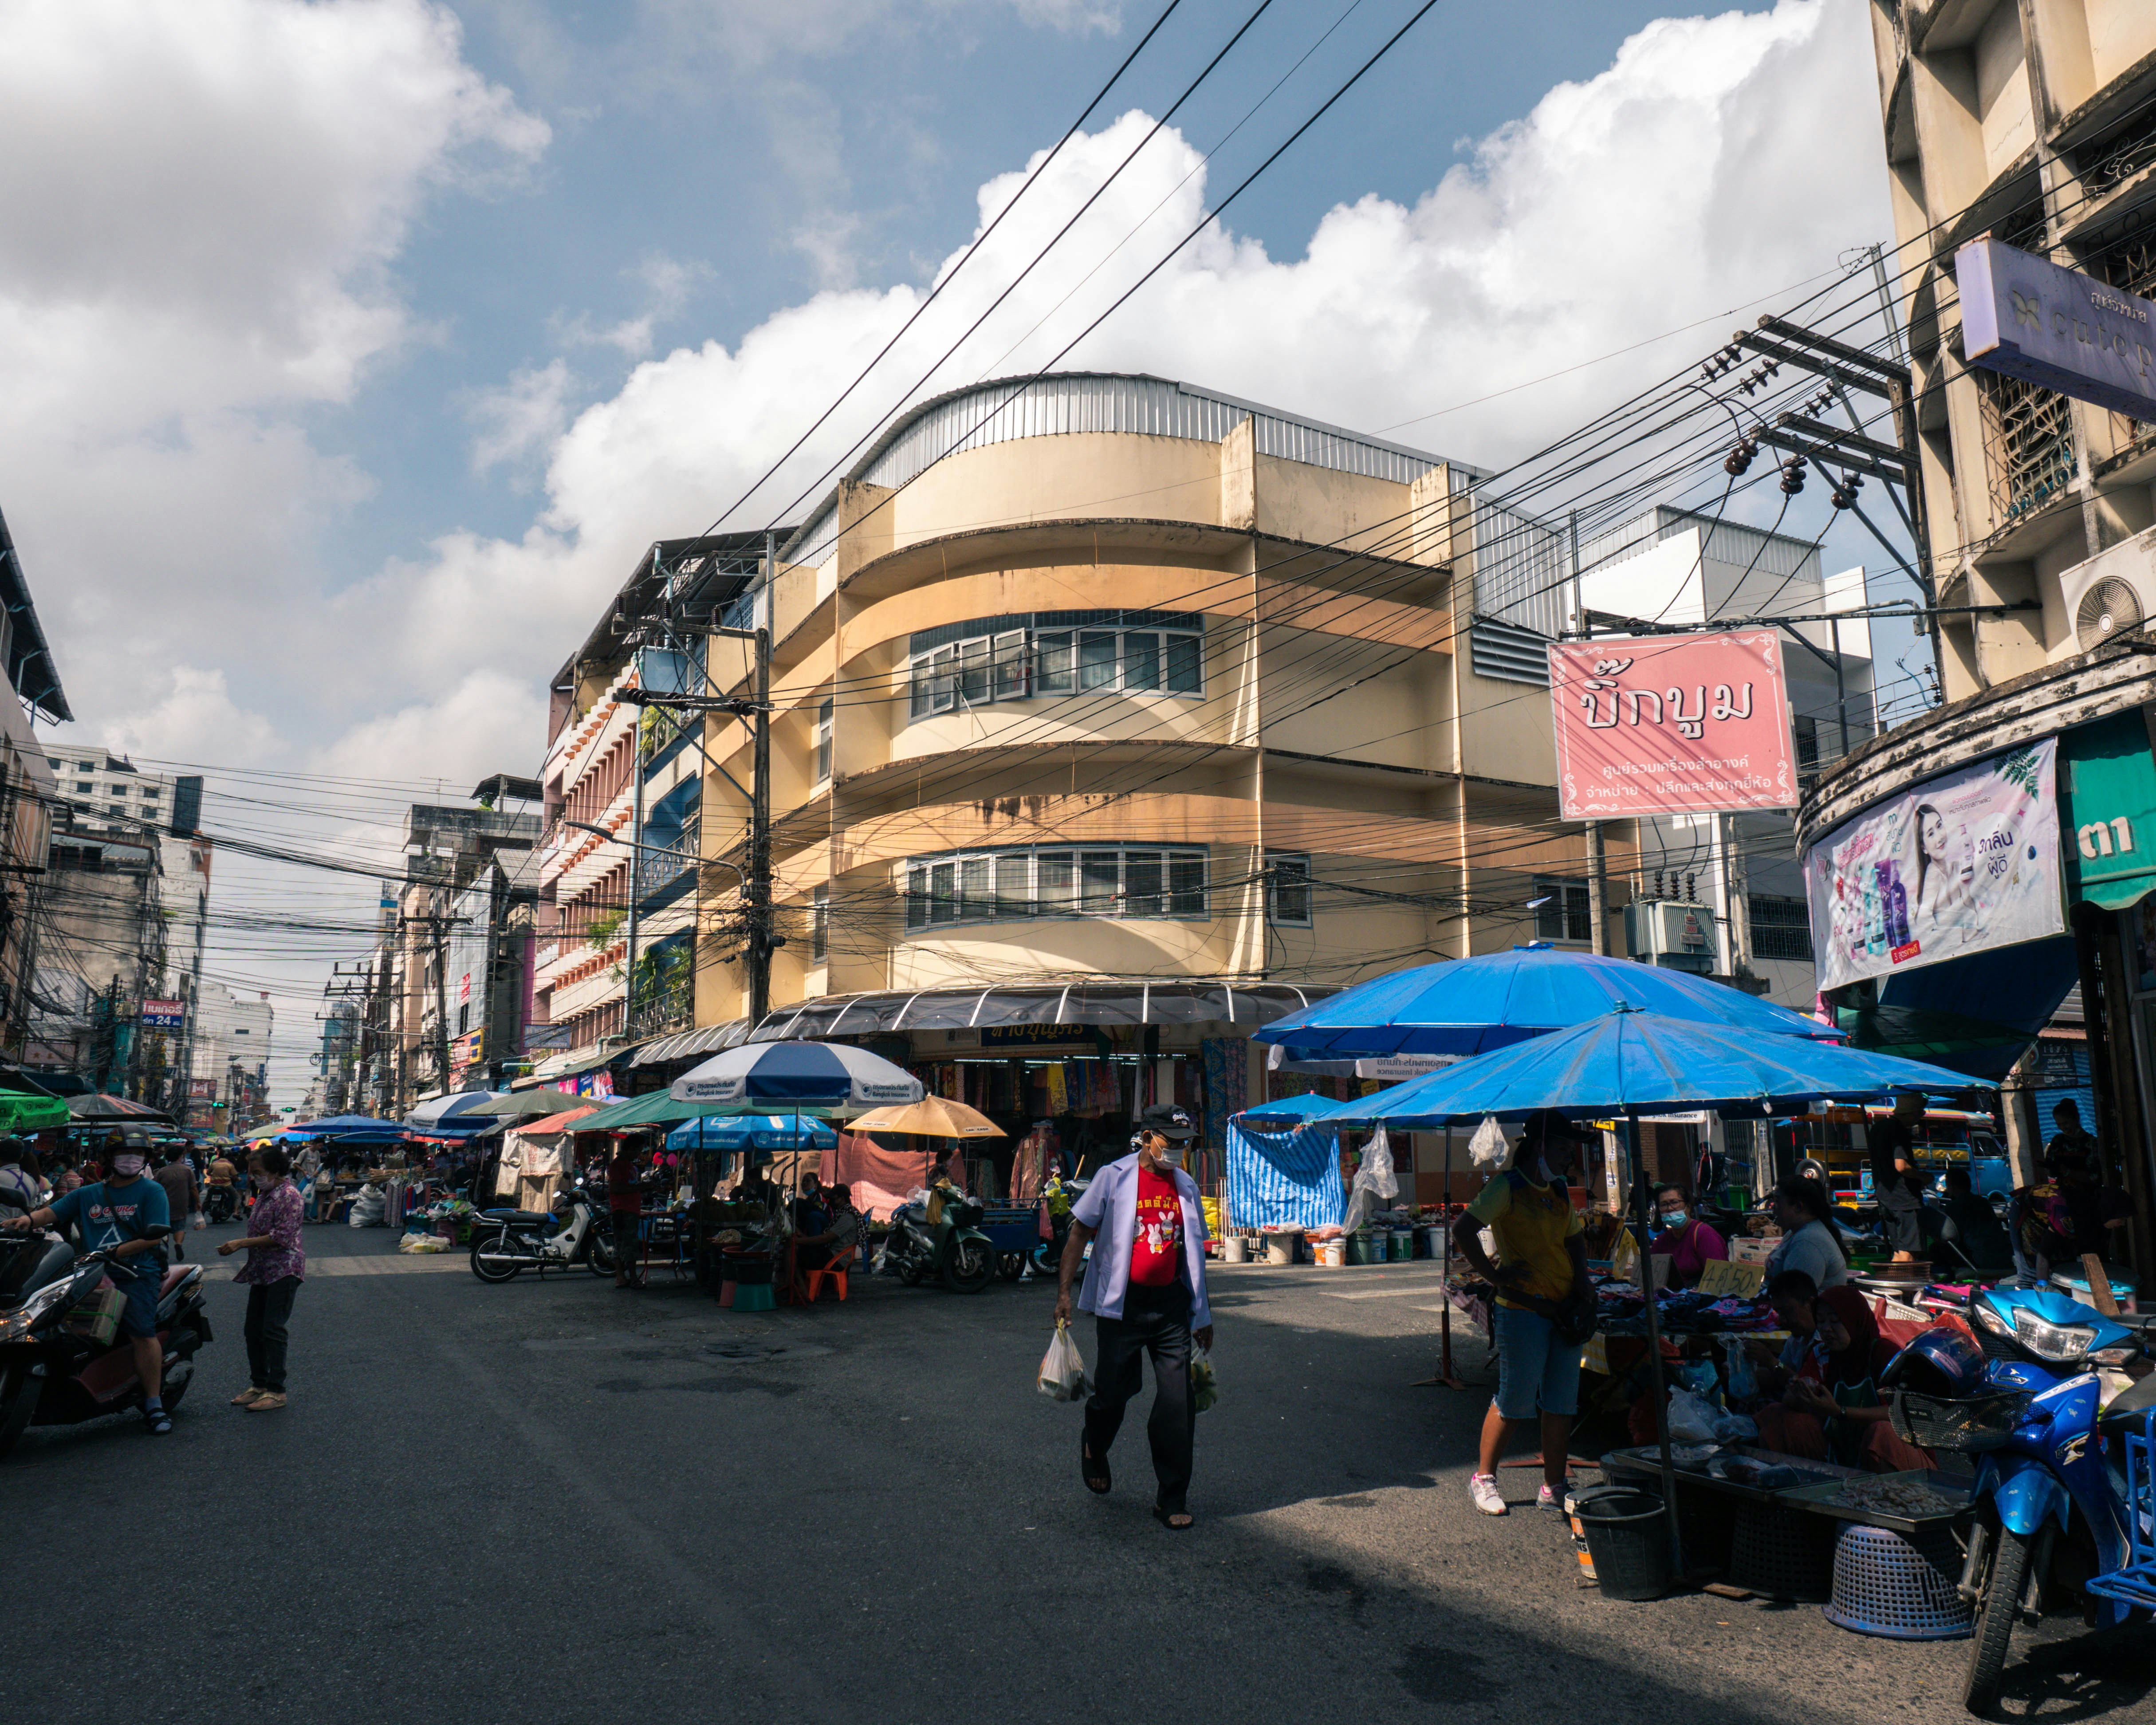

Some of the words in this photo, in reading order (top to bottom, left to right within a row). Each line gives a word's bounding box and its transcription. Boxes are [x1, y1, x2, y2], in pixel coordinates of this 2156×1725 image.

[2091, 292, 2147, 323] ศูนย์จำหน่าย
[1580, 658, 1753, 740] บิ๊กบูม
[1602, 755, 1749, 780] ศูนย์รวมเครื่องสำอางค์
[1586, 785, 1638, 799] จำหน่าย
[1656, 773, 1771, 794] ปลีกและส่งทุกยี่ห้อ
[157, 1015, 171, 1025] 24
[697, 1081, 736, 1091] กรุงเทพประกันภัย
[102, 1205, 135, 1215] OURA
[1703, 1265, 1715, 1289] 4
